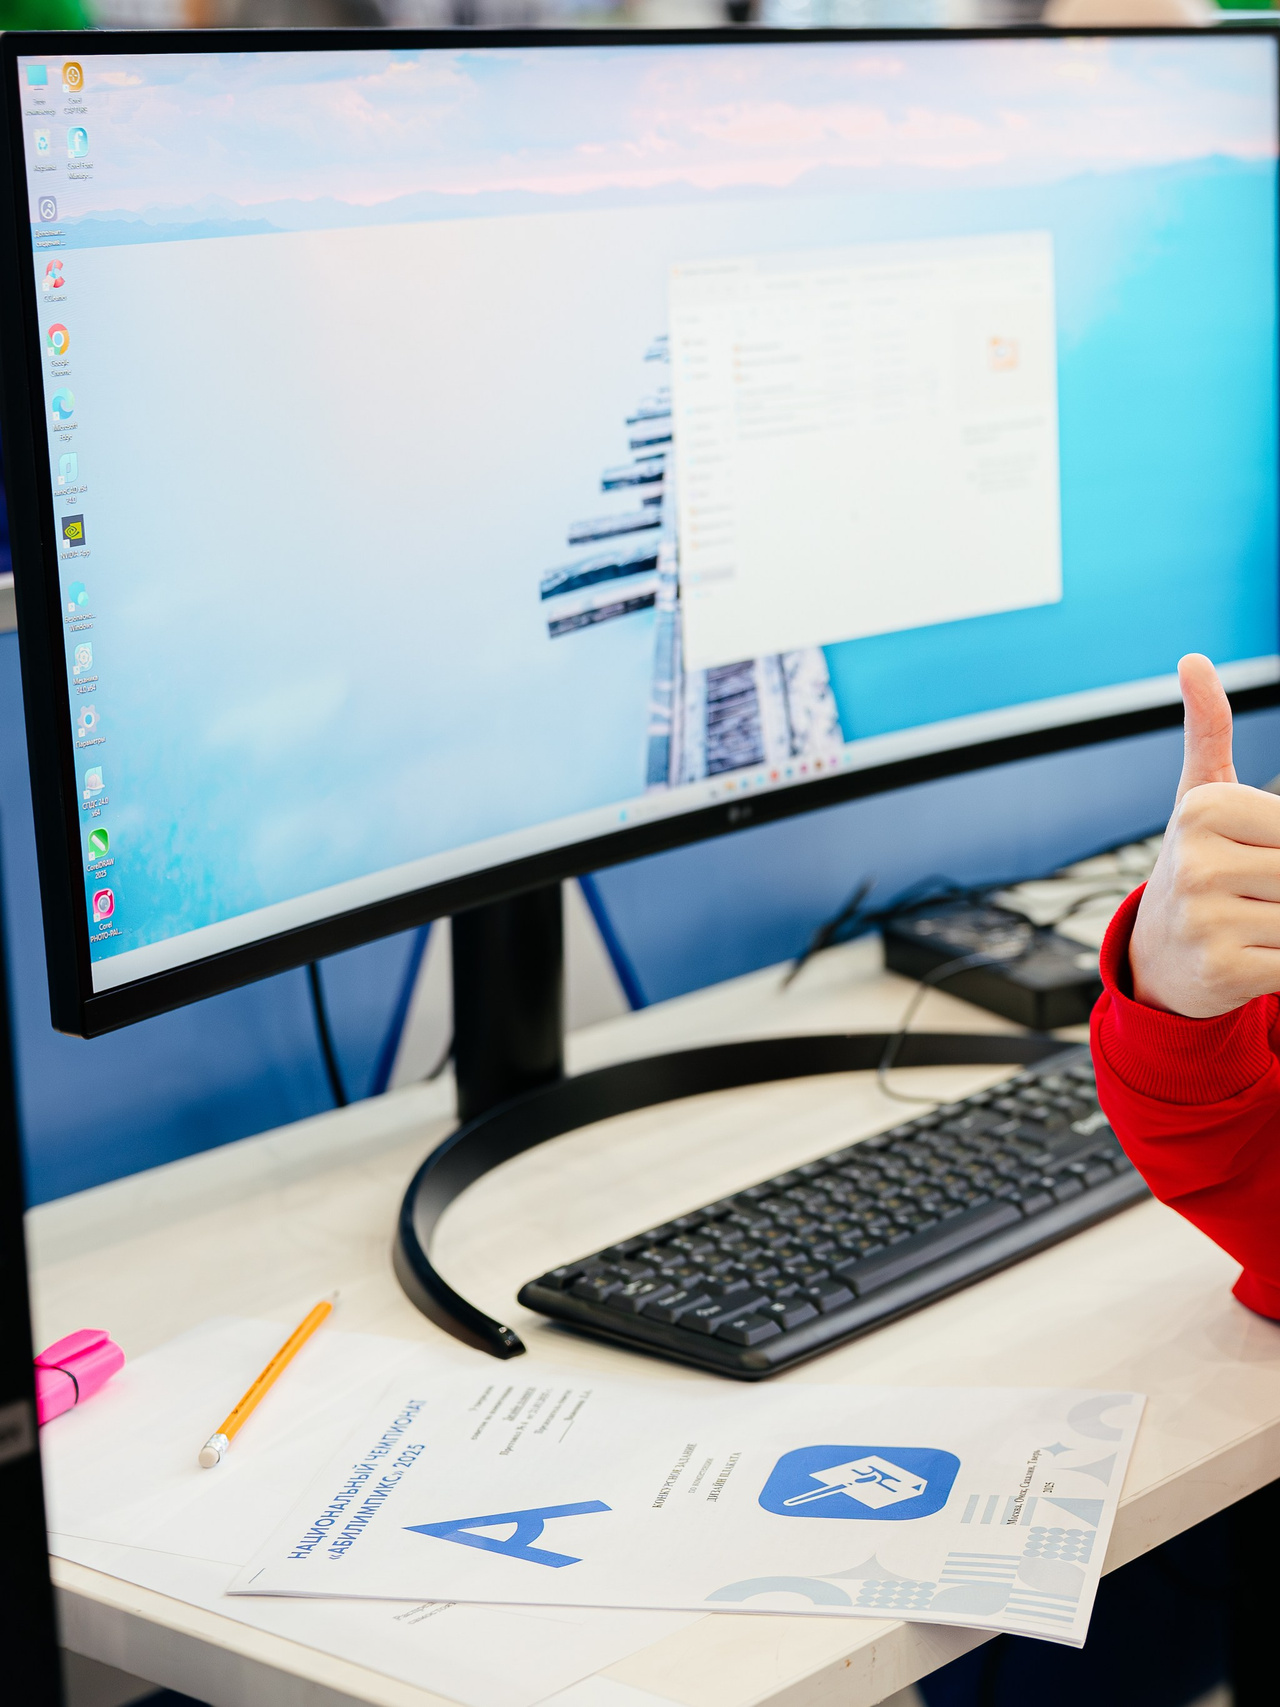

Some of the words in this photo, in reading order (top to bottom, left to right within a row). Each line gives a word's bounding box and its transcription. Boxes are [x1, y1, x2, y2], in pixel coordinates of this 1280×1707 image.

[287, 1463, 379, 1560] НАЦИОНАЛЬНЫЙ
[364, 1399, 428, 1461] ЧЕМПИОНАТ
[651, 1468, 683, 1509] КОНКУРСНОЕ
[706, 1478, 728, 1503] ДИЗАЙН
[328, 1470, 405, 1561] «АБИЛИМПИКС»
[392, 1443, 426, 1468] 2025
[1006, 1503, 1024, 1526] Москва,
